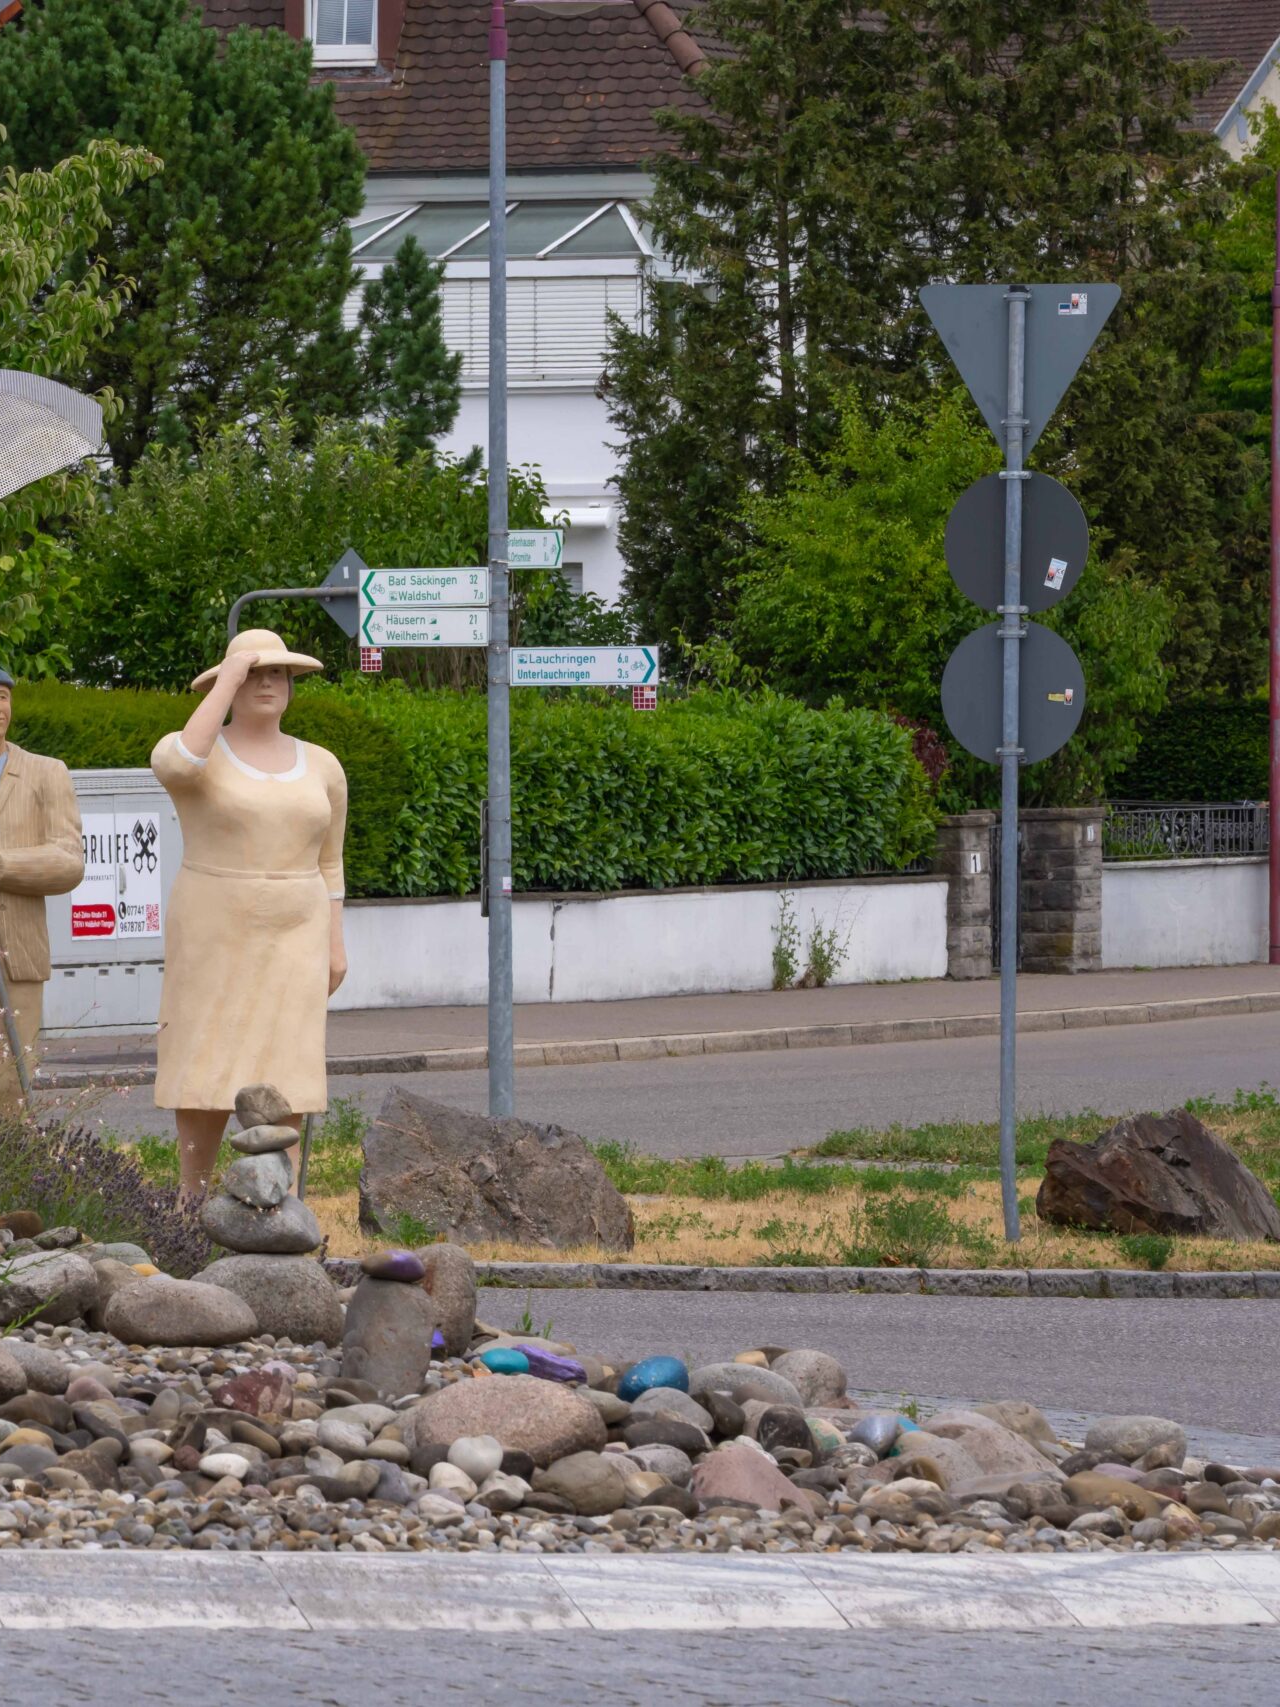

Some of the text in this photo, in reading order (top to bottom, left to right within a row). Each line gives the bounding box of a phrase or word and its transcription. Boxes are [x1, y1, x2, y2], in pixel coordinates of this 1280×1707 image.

[388, 574, 478, 587] Bad Säckingen 32
[399, 591, 440, 601] Waldshut
[386, 614, 478, 625] Häusern 21
[386, 630, 428, 641] Weilheim
[529, 654, 596, 667] Lauchringen
[517, 669, 590, 681] Unterlauchringen
[972, 854, 978, 873] 1
[127, 905, 145, 917] 07741
